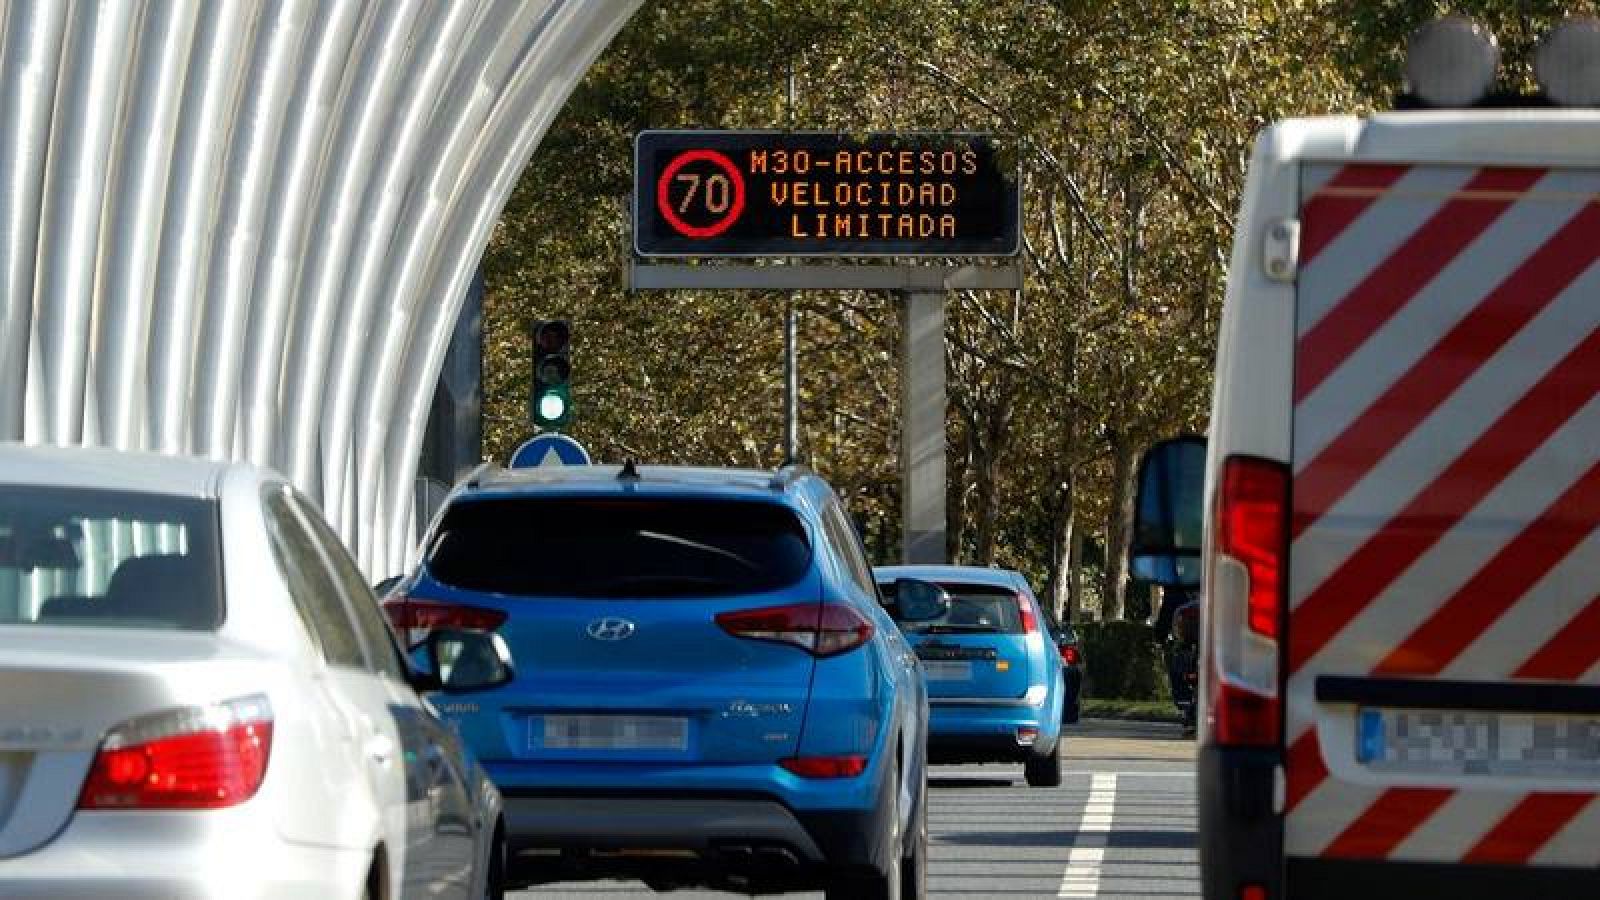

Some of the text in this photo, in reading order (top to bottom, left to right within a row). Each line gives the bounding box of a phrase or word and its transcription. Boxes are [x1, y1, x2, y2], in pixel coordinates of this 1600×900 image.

[750, 151, 978, 175] M30-ACCESOS
[676, 174, 730, 214] 70
[771, 182, 957, 207] VELOCIDAD
[791, 214, 956, 239] LIMITADA
